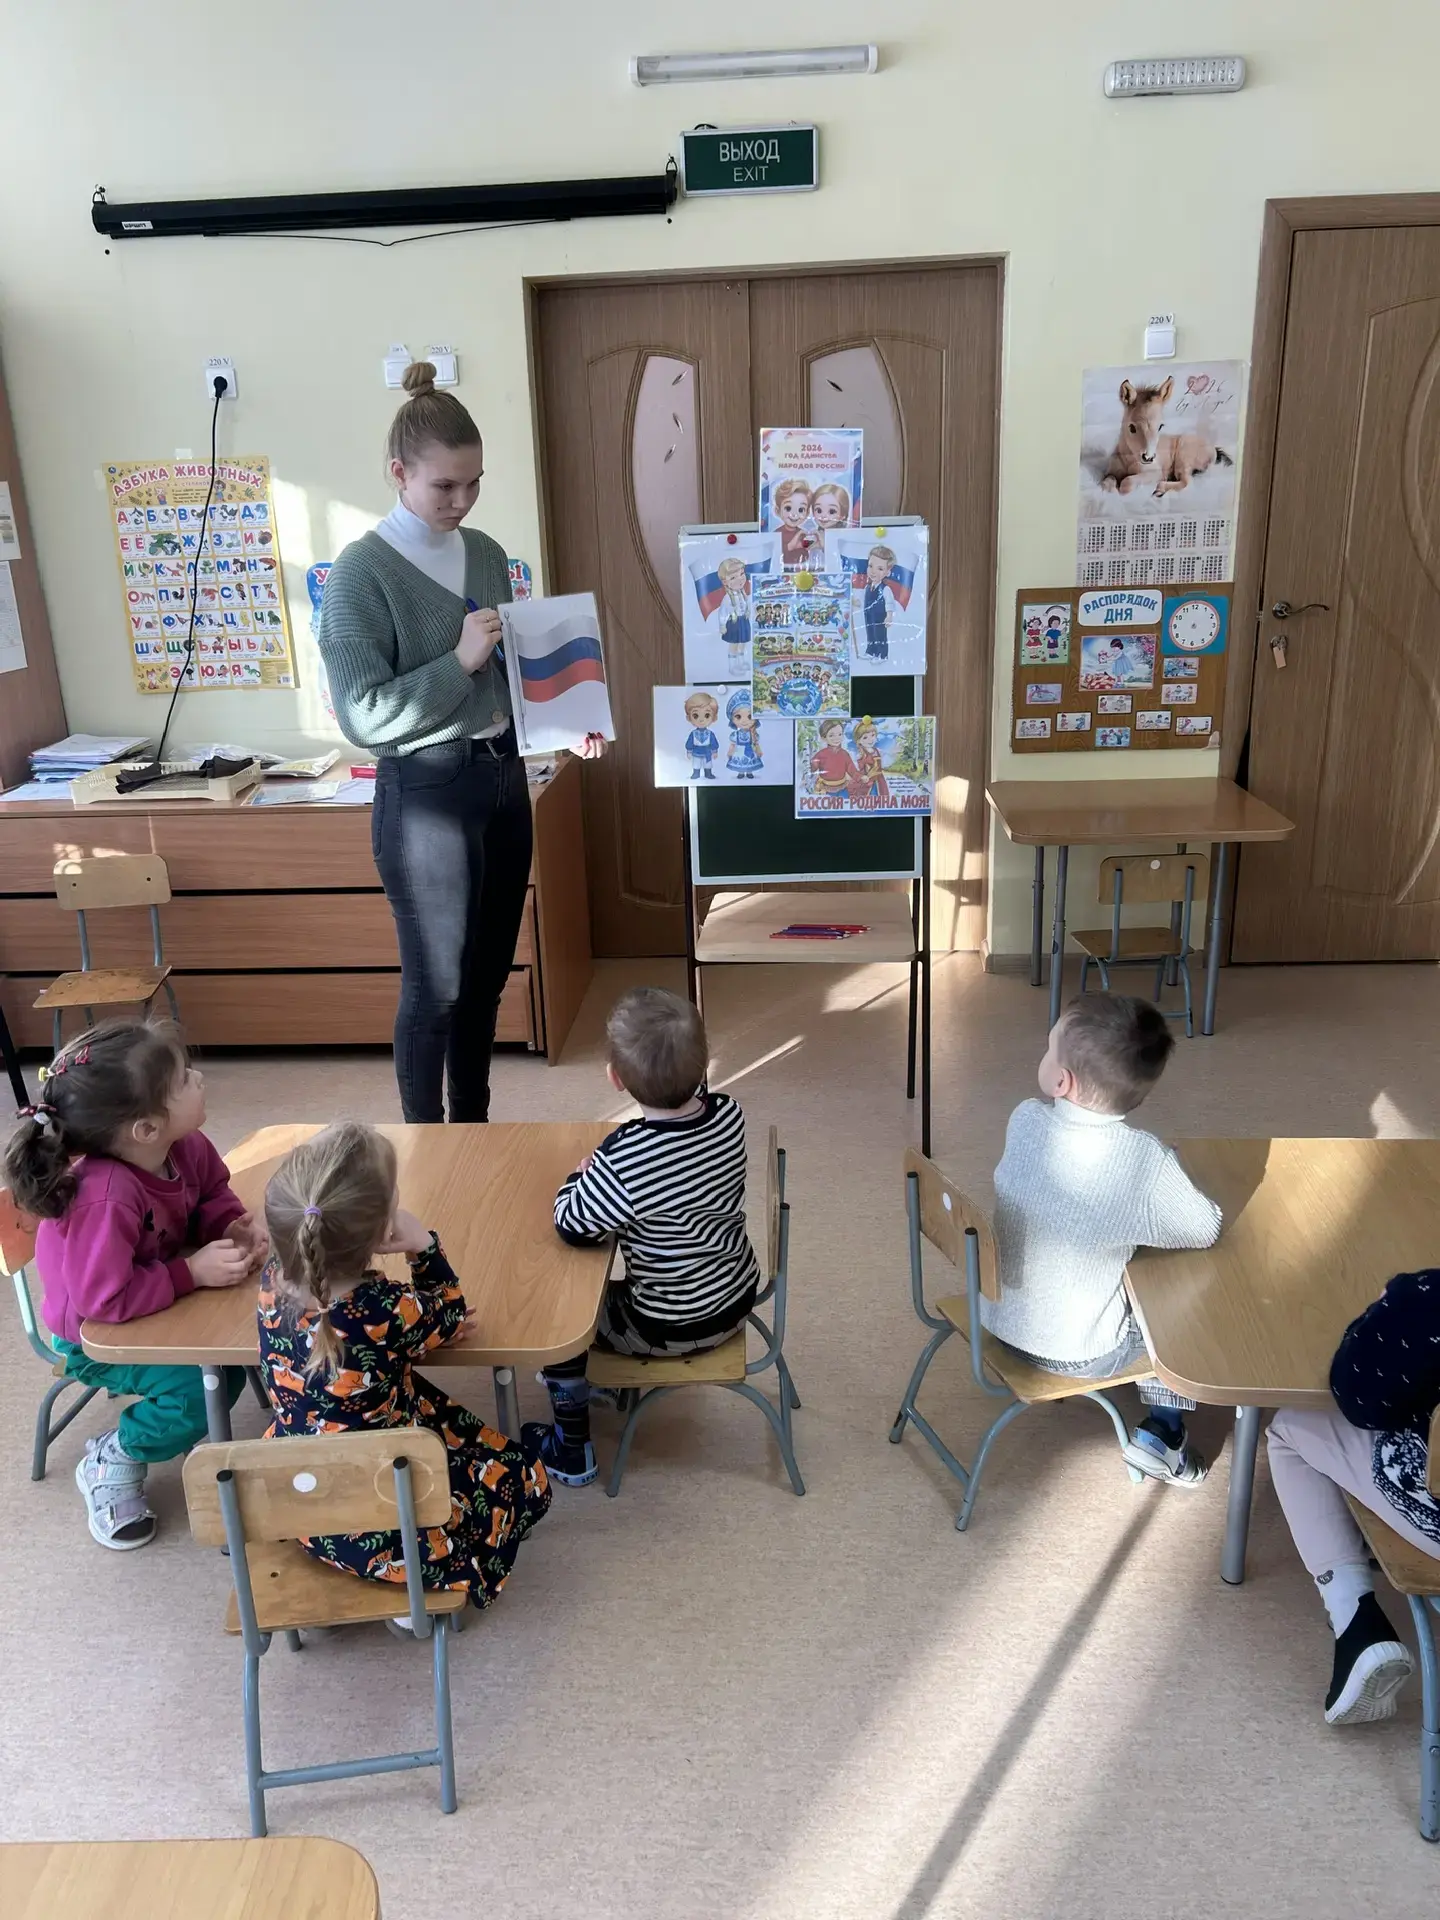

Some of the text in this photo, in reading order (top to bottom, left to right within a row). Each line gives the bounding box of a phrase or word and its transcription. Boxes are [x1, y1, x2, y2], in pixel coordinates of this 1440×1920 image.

[720, 139, 780, 163] ВЫХОД
[733, 165, 768, 182] EXIT
[1150, 315, 1172, 325] 220 V
[431, 346, 443, 354] 220
[209, 357, 229, 366] 220 V
[801, 444, 822, 452] 2026
[113, 467, 169, 496] АЗБУКА
[174, 465, 262, 488] ЖИВОТНЫХ
[117, 505, 254, 523] А Б В Г Д
[120, 533, 254, 550] Е Ё Ж З И
[124, 562, 134, 576] Й
[155, 563, 165, 576] К
[217, 560, 230, 572] М
[248, 559, 257, 571] Н
[128, 591, 139, 602] О
[159, 590, 169, 601] П
[221, 587, 232, 598] С
[251, 586, 259, 597] Т
[1083, 593, 1158, 614] РАСПОРЯДОК
[131, 612, 264, 629] У Ф Х Ц Ч
[1104, 607, 1133, 623] ДНЯ
[135, 639, 257, 654] Ш Щ Ъ Ы Ь
[170, 664, 241, 678] Э Ю Я
[901, 794, 930, 808] МОЯ!
